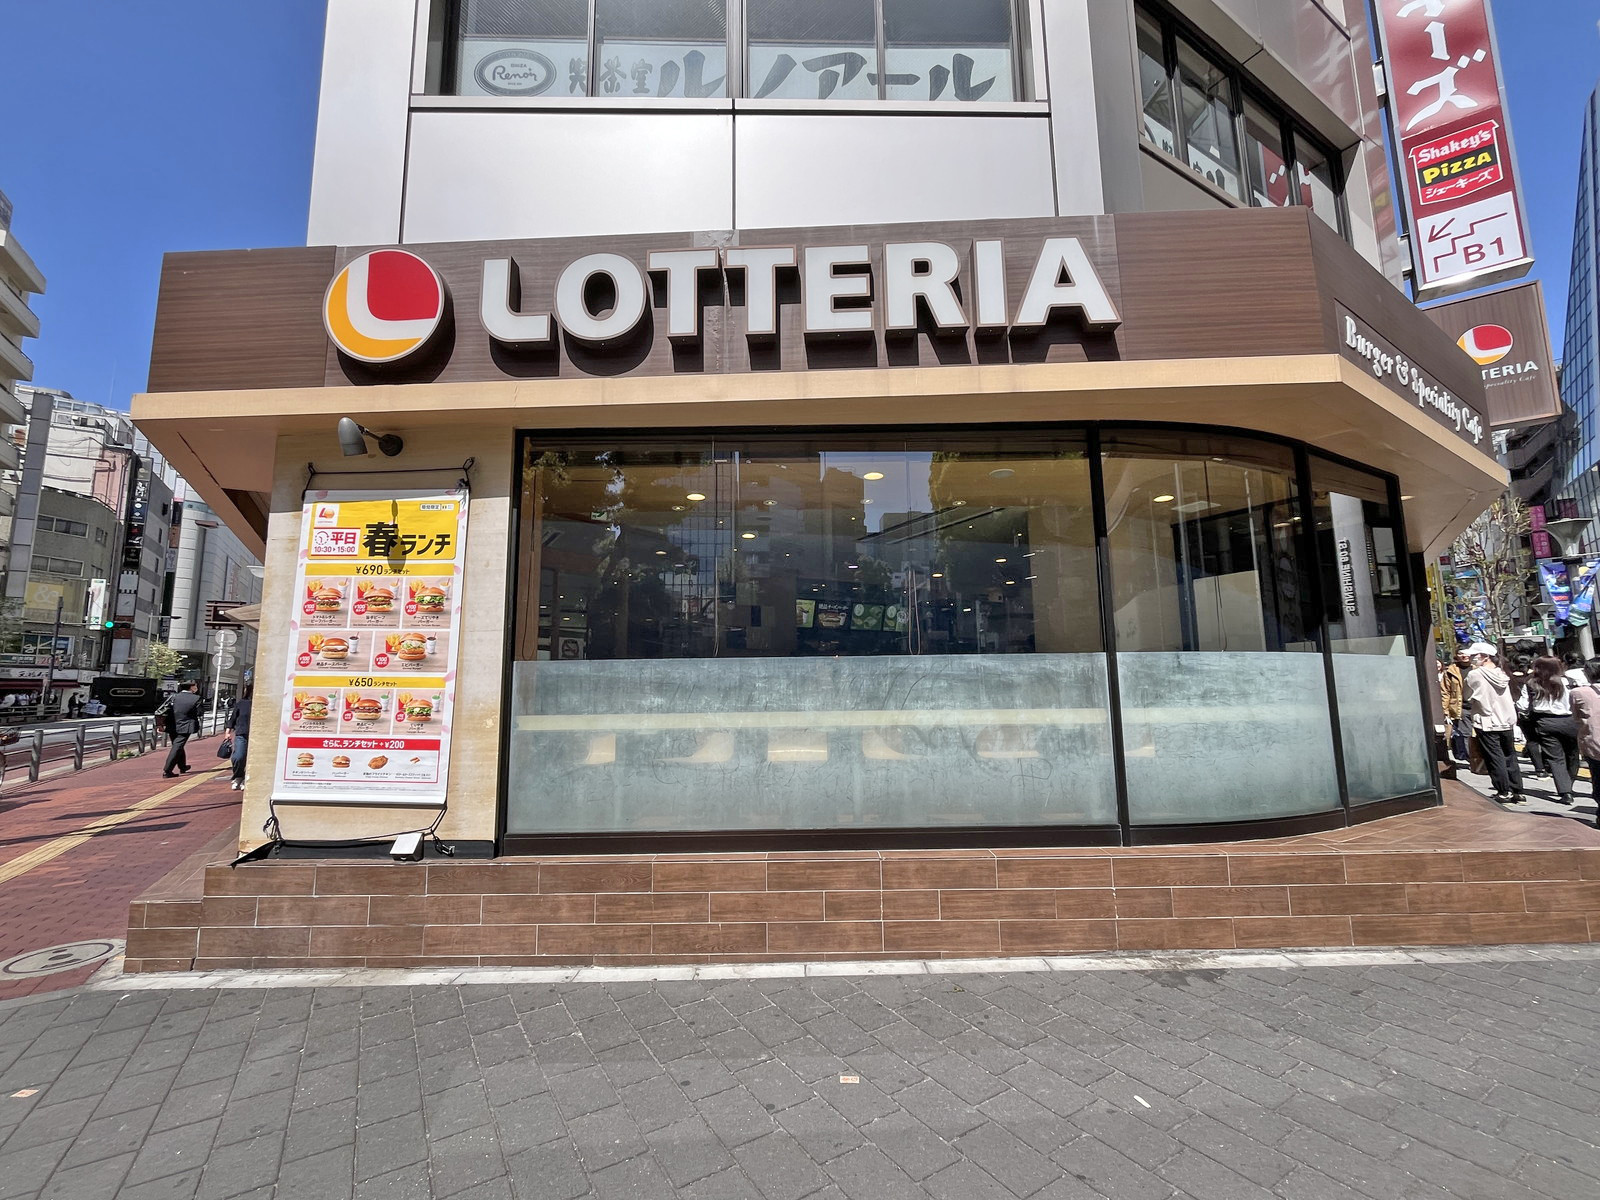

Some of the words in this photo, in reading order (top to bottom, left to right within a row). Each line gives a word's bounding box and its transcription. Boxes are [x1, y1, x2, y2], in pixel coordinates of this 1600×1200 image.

[492, 65, 538, 82] Renoir
[1417, 129, 1492, 164] Shakey's
[1425, 167, 1494, 199] シェーキーズ
[1463, 236, 1504, 265] B1
[480, 237, 1122, 344] LOTTERIA
[1345, 315, 1394, 377] Burger
[1395, 355, 1409, 386] &
[330, 531, 357, 545] 平日
[362, 521, 451, 557] 春ランチ
